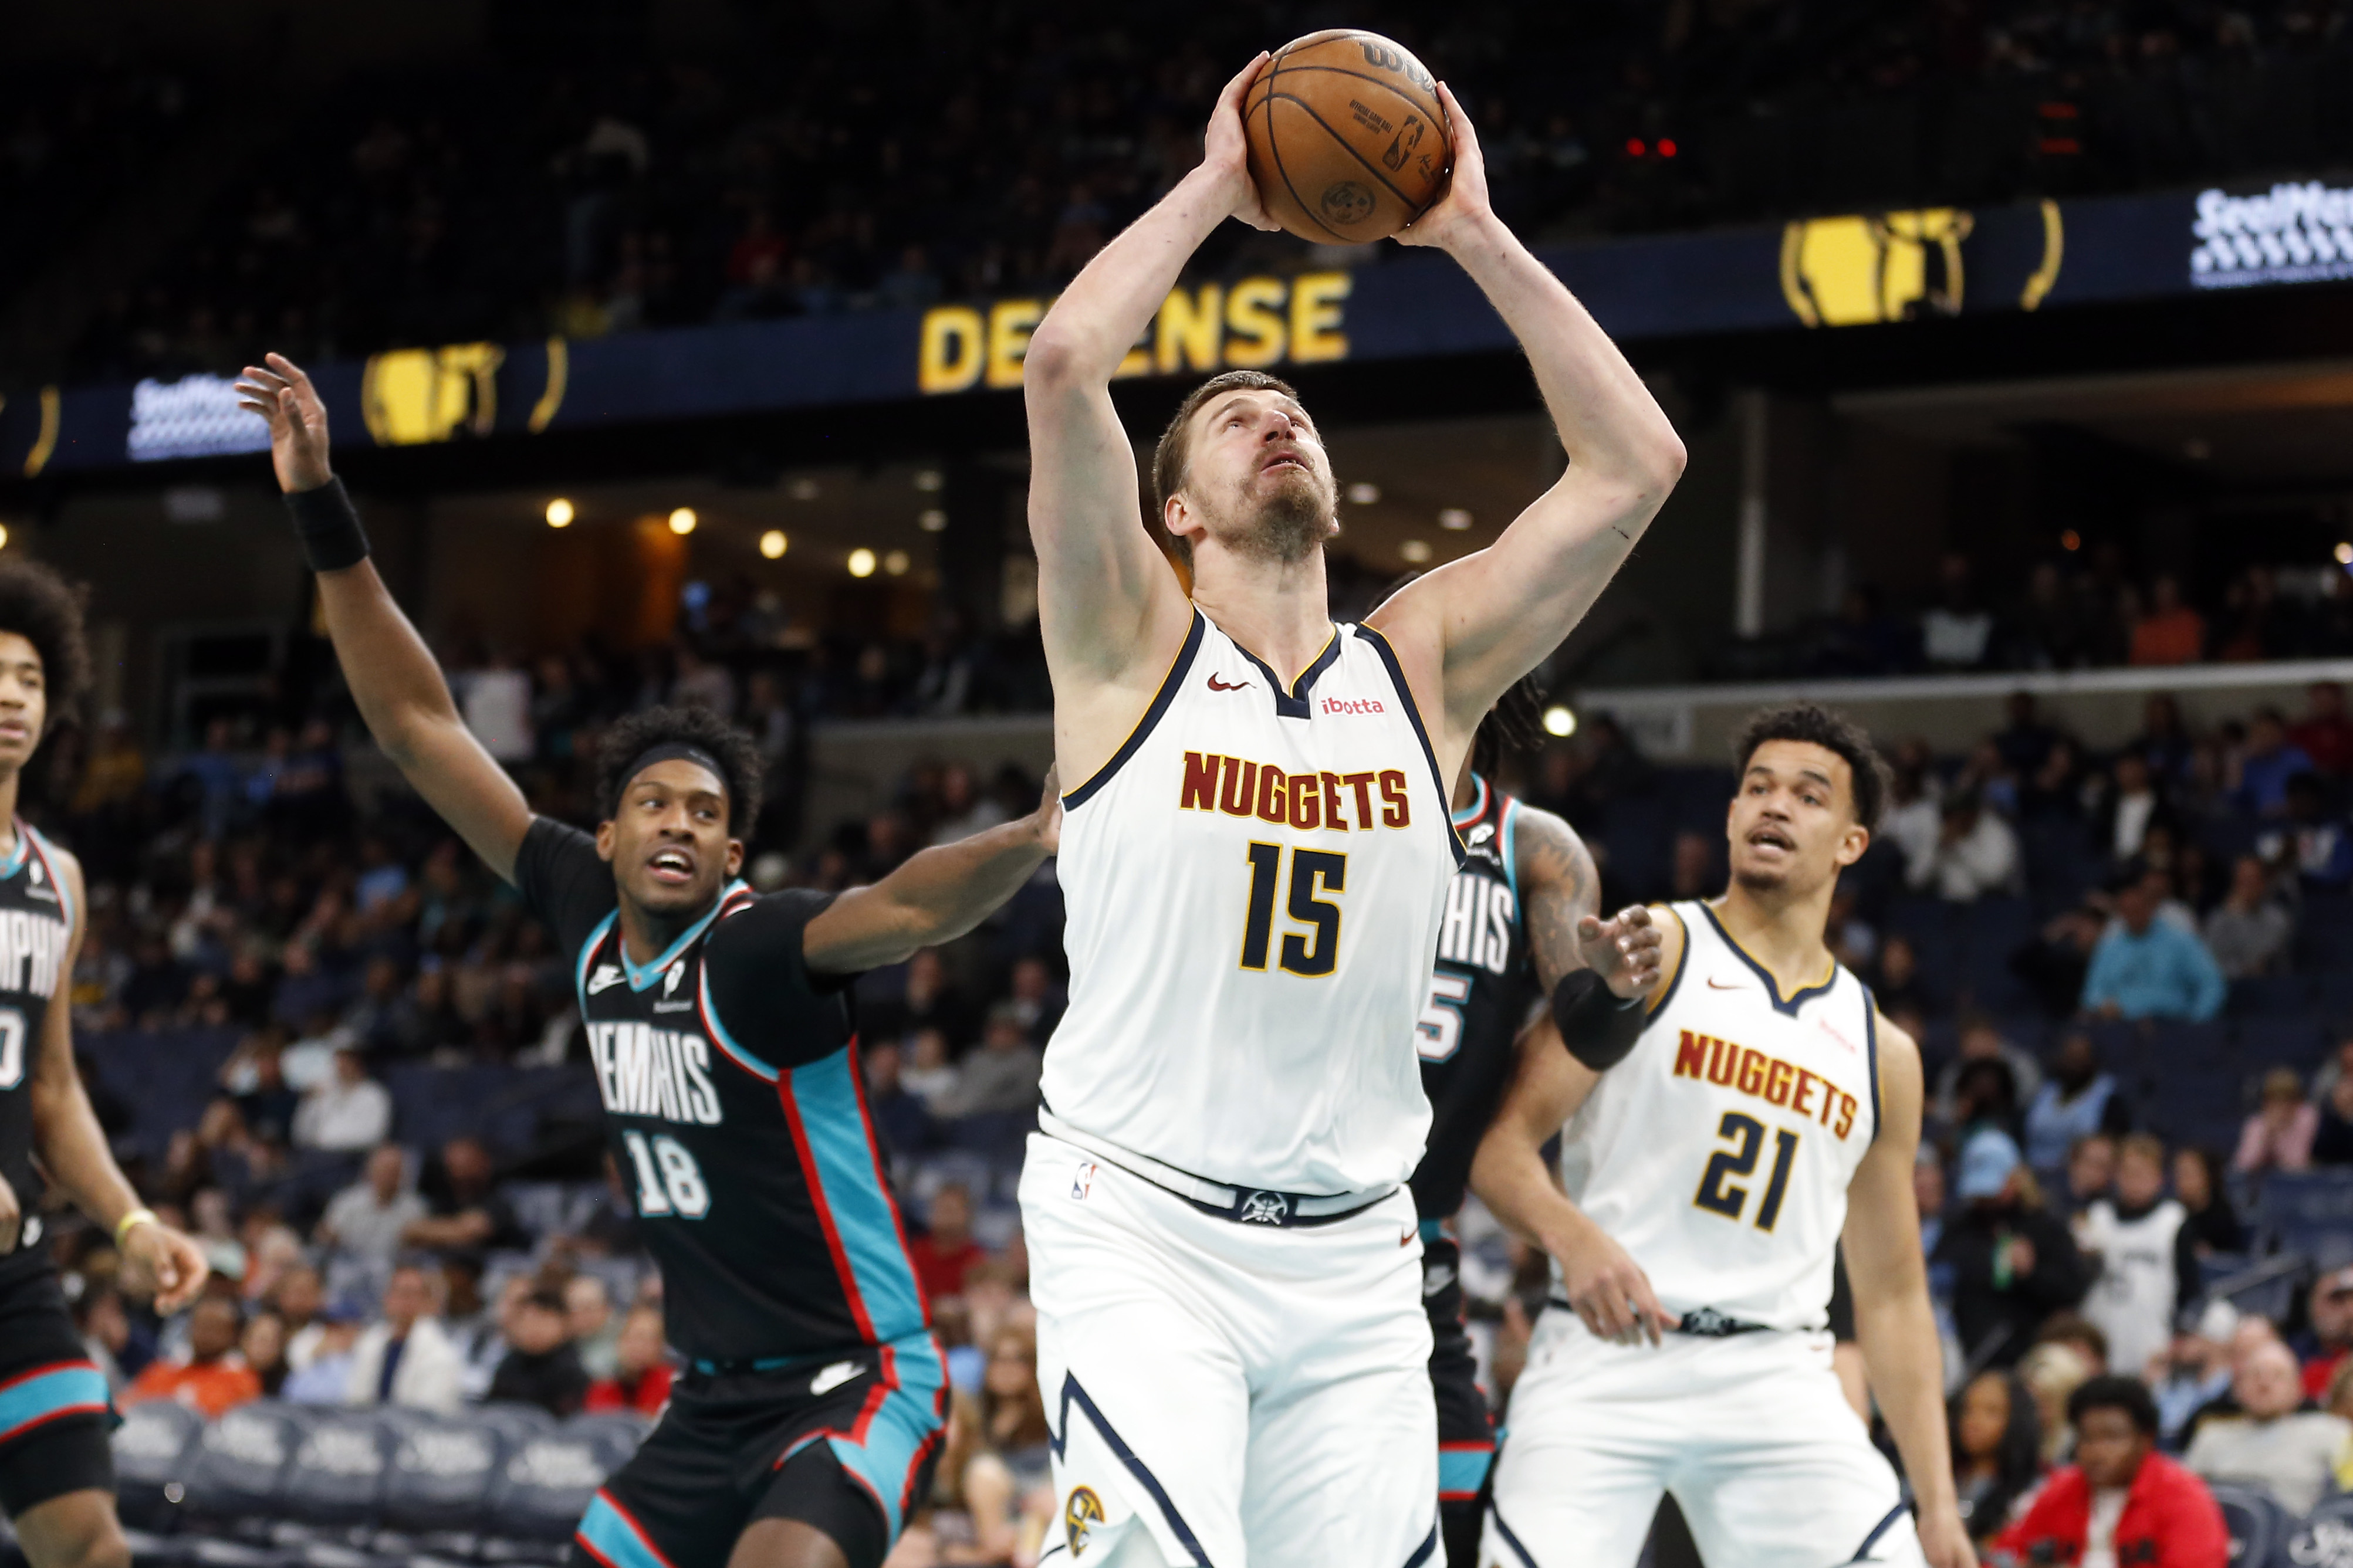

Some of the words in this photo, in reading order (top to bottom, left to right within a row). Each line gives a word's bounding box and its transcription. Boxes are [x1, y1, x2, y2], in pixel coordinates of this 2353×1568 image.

[918, 271, 1352, 395] DENSE
[1320, 697, 1385, 716] ibotta
[1179, 750, 1411, 832] NUGGETS
[1239, 839, 1348, 978] 15
[1672, 1028, 1858, 1141] NUGGETS
[623, 1128, 712, 1220] 18
[1692, 1110, 1801, 1236] 21
